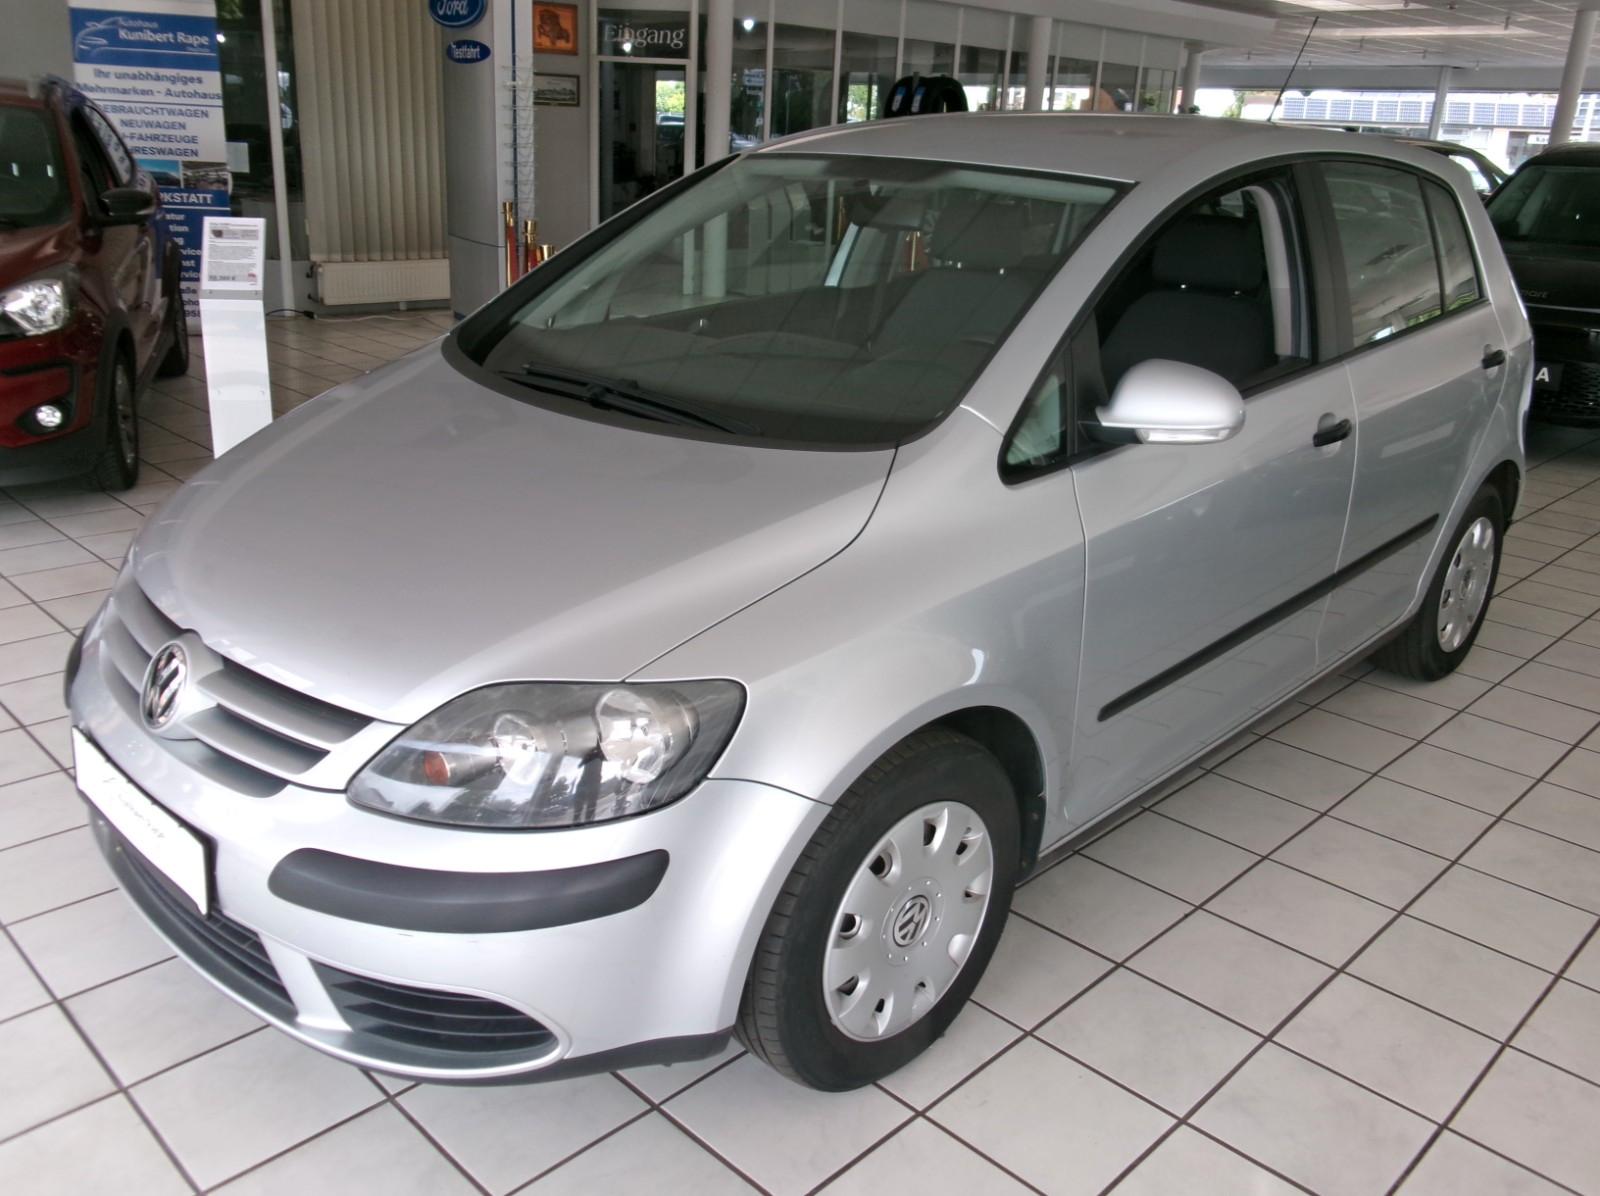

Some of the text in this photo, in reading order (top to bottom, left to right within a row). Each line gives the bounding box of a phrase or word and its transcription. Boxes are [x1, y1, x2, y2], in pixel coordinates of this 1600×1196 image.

[118, 28, 209, 47] Kunibert Rape
[605, 24, 685, 49] Eingang
[94, 68, 203, 85] Ihr unabhängiges
[165, 87, 223, 100] Autohaus
[100, 104, 209, 119] EBRAUCHTWAGEN
[120, 119, 187, 130] NEUWAGEN
